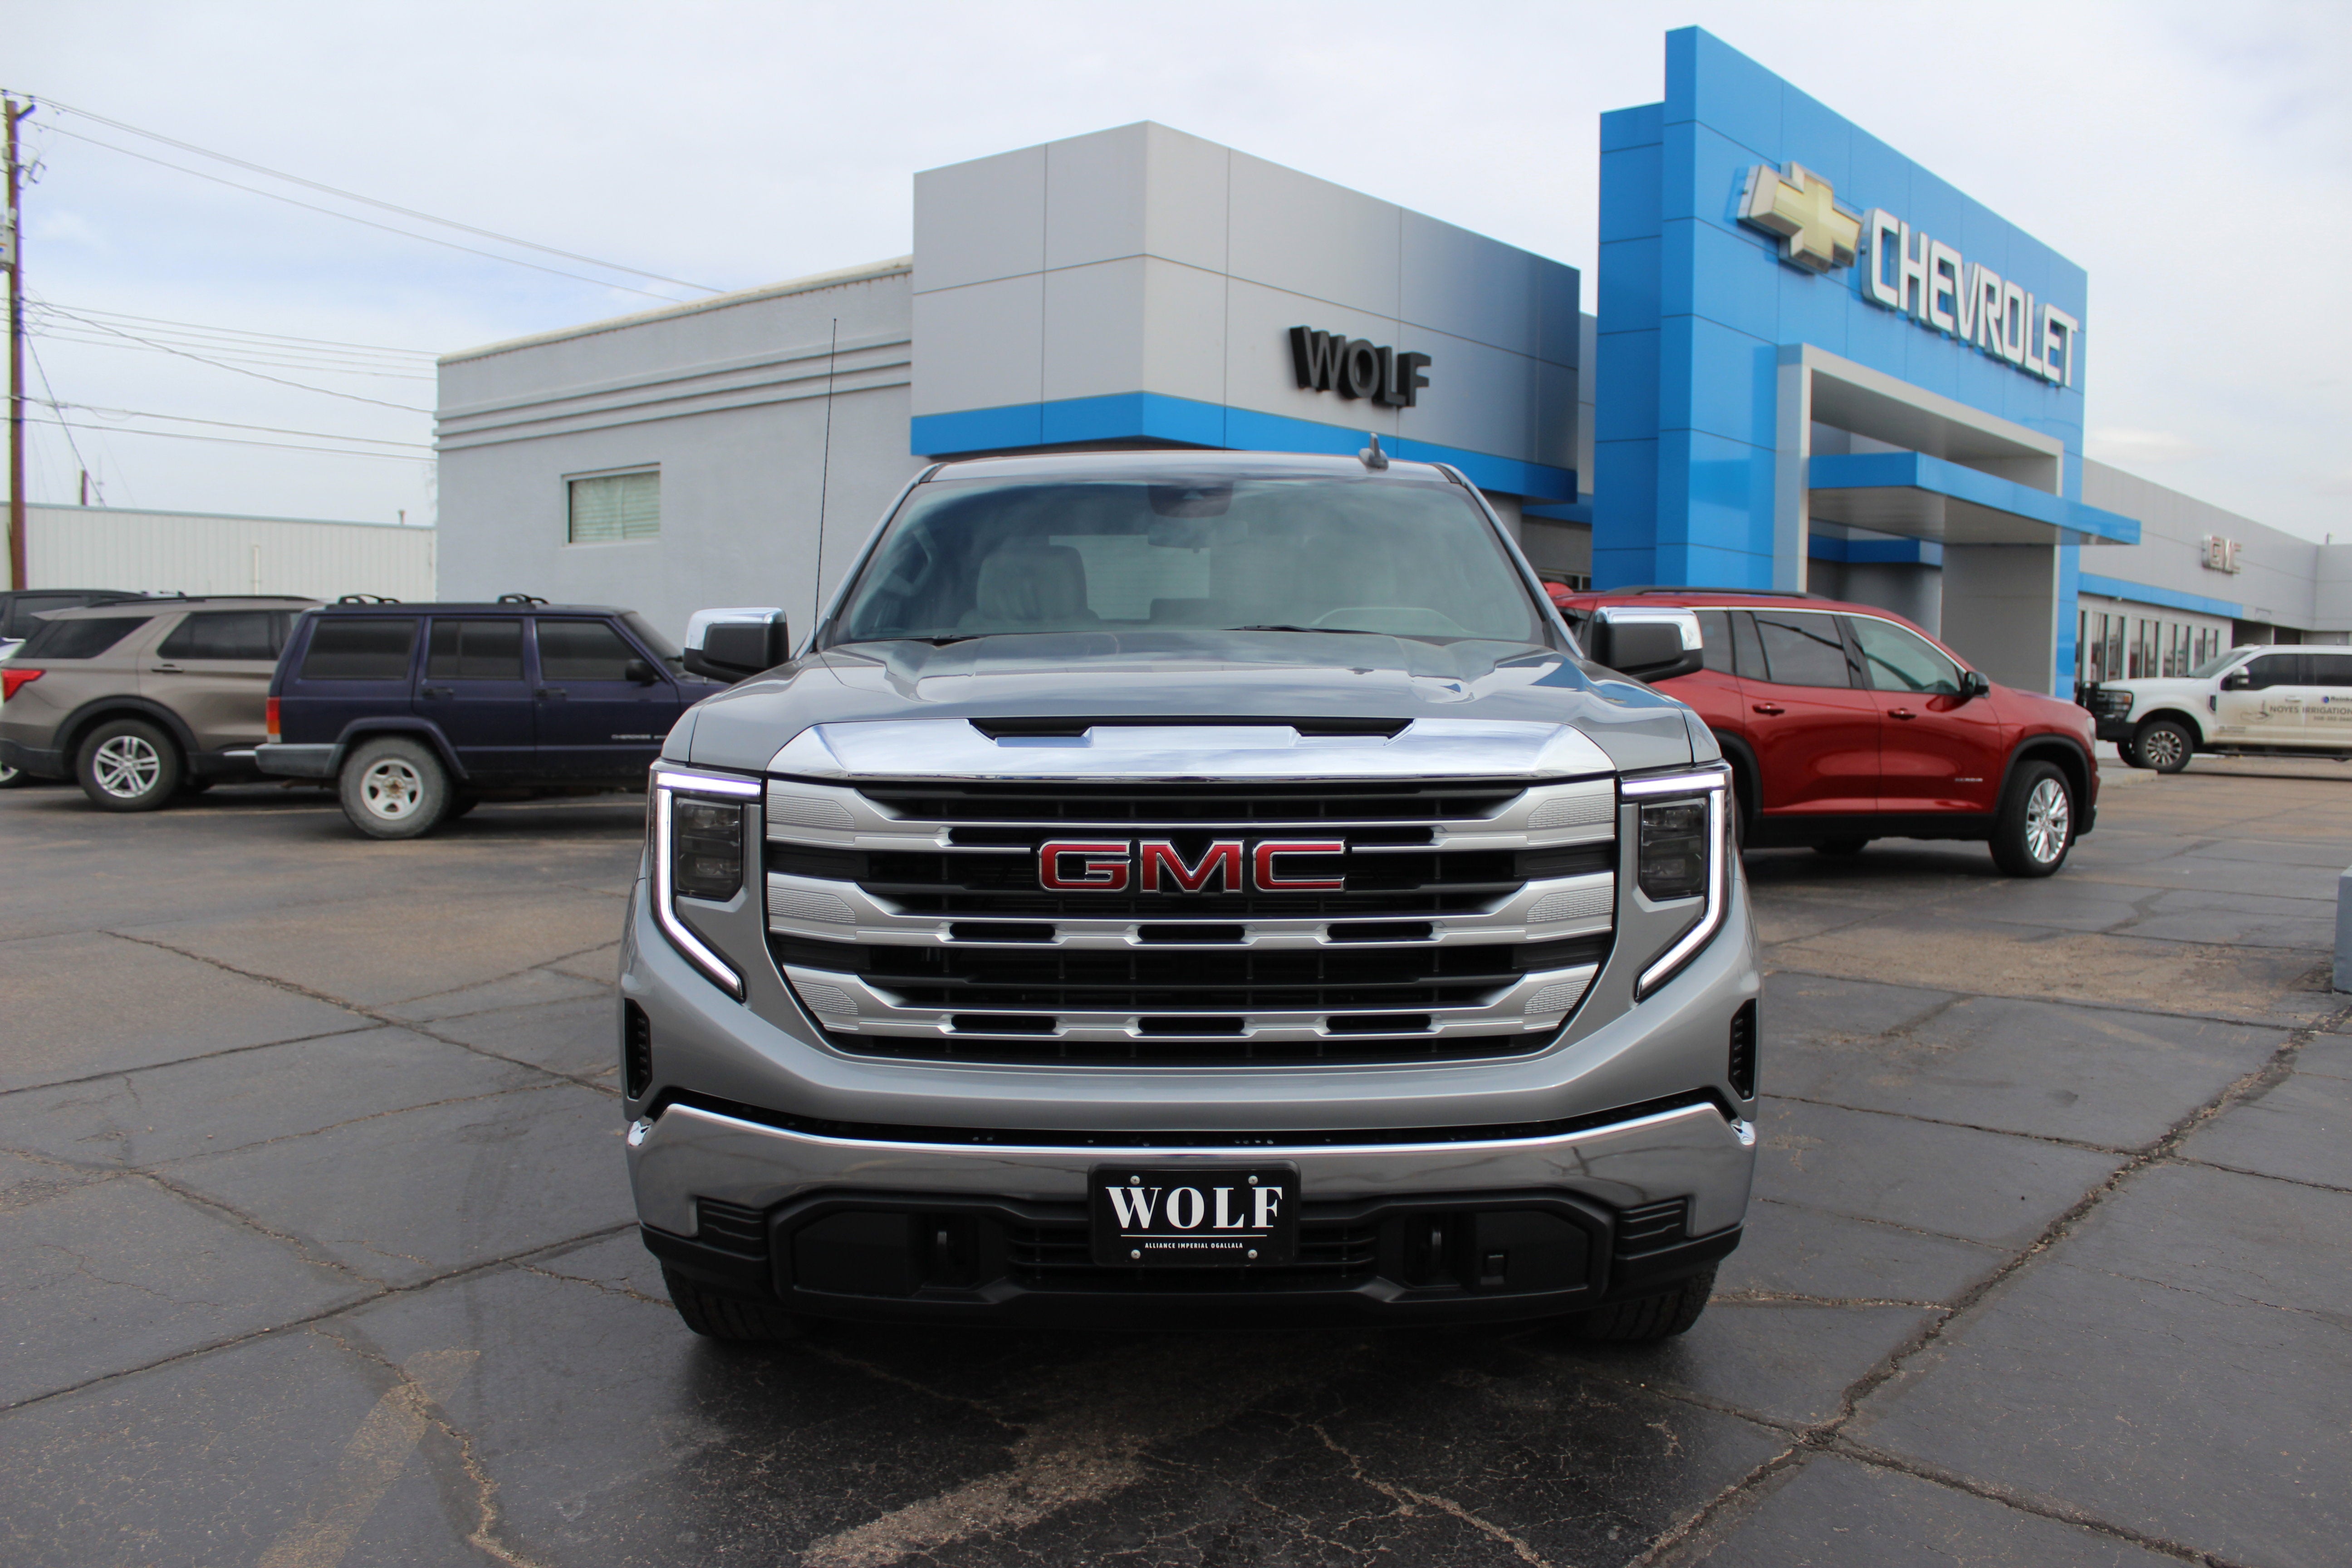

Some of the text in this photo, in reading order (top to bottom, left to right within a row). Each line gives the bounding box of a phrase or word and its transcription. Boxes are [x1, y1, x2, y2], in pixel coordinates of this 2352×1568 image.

[1863, 207, 2078, 387] CHEVROLET
[1289, 325, 1431, 407] WOLF
[1037, 839, 1346, 893] GMC
[1105, 1187, 1283, 1229] WOLF
